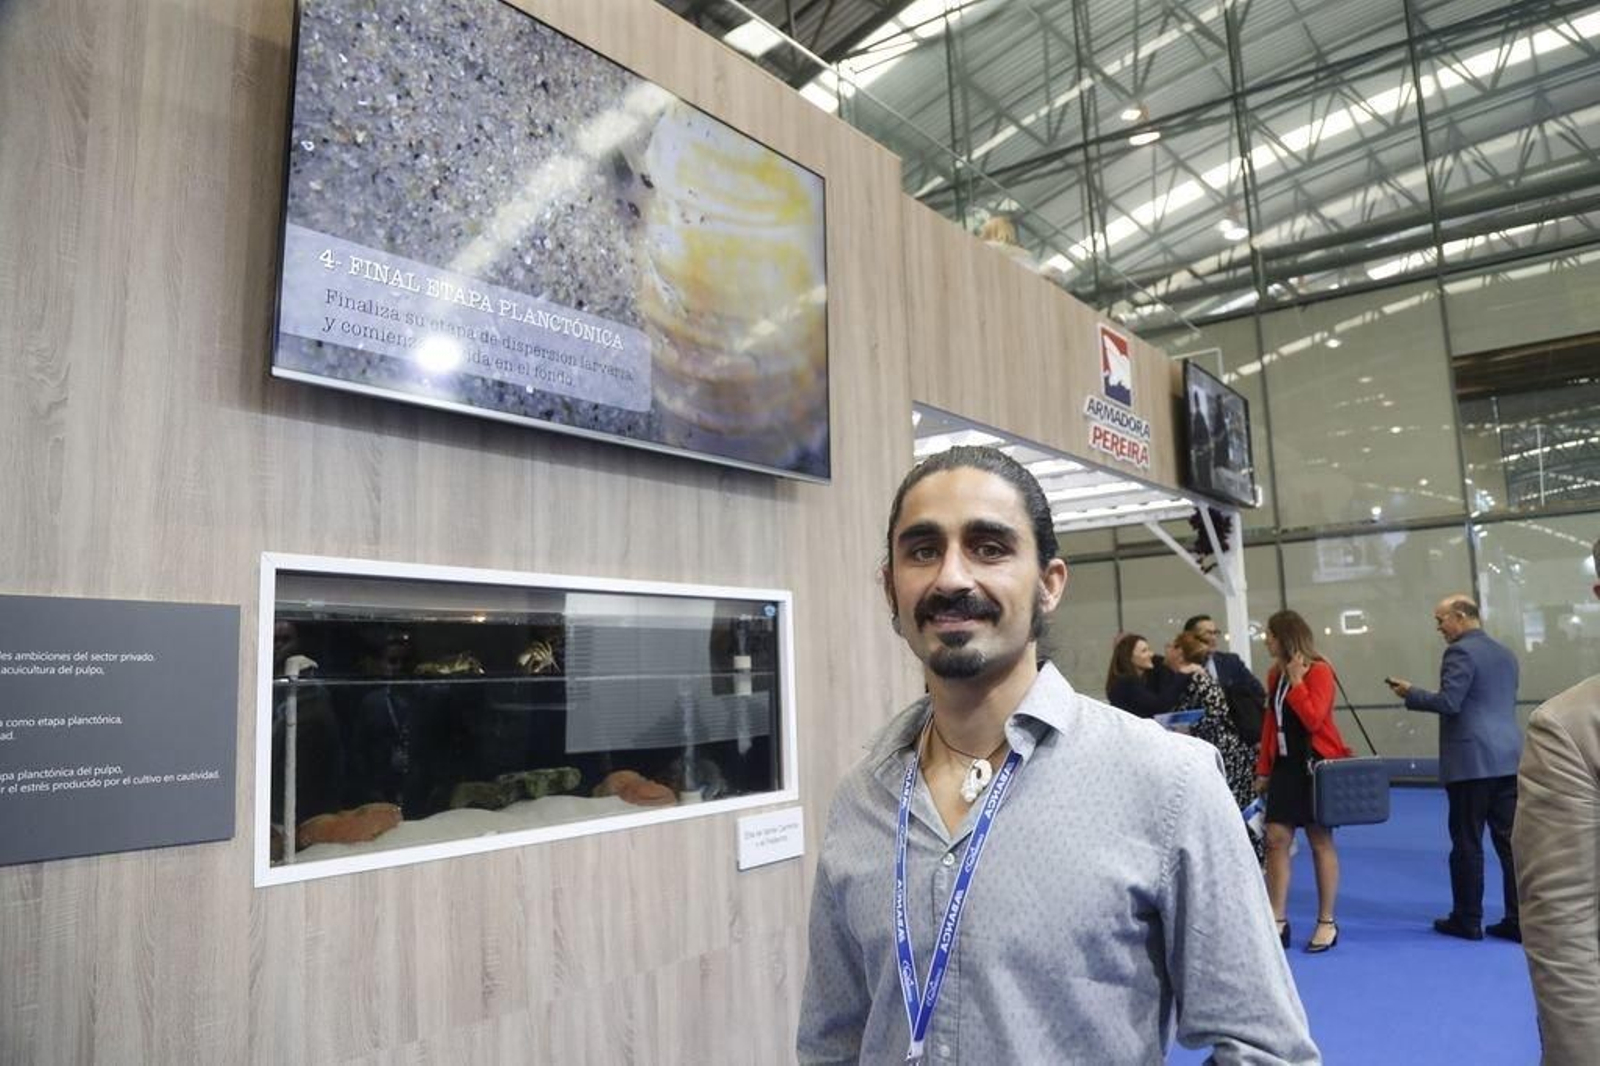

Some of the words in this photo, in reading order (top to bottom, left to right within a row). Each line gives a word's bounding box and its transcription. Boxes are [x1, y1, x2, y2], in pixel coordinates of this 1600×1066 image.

[325, 288, 401, 322] Finaliza
[405, 312, 425, 328] su
[428, 317, 475, 339] etapa
[480, 329, 498, 346] de
[349, 255, 421, 293] FINAL
[425, 277, 495, 313] ETAPA
[499, 298, 625, 350] PLANCTÓNICA
[322, 316, 336, 332] y
[341, 319, 421, 349] comienz
[495, 357, 513, 372] en
[517, 361, 530, 376] el
[1086, 397, 1151, 439] ARMADORA
[1092, 425, 1149, 465] PEREIRA
[1, 665, 55, 675] acuicultura
[58, 665, 73, 675] del
[15, 651, 71, 661] ambiciones
[73, 651, 88, 661] del
[91, 652, 118, 661] sector
[6, 719, 35, 727] como
[38, 717, 66, 729] etapa
[8, 783, 18, 794] el
[52, 778, 102, 792] producido
[104, 777, 120, 789] por
[122, 775, 131, 785] el
[133, 773, 162, 785] cultivo
[164, 773, 175, 782] en
[17, 766, 75, 781] planctónica
[77, 765, 92, 776] del
